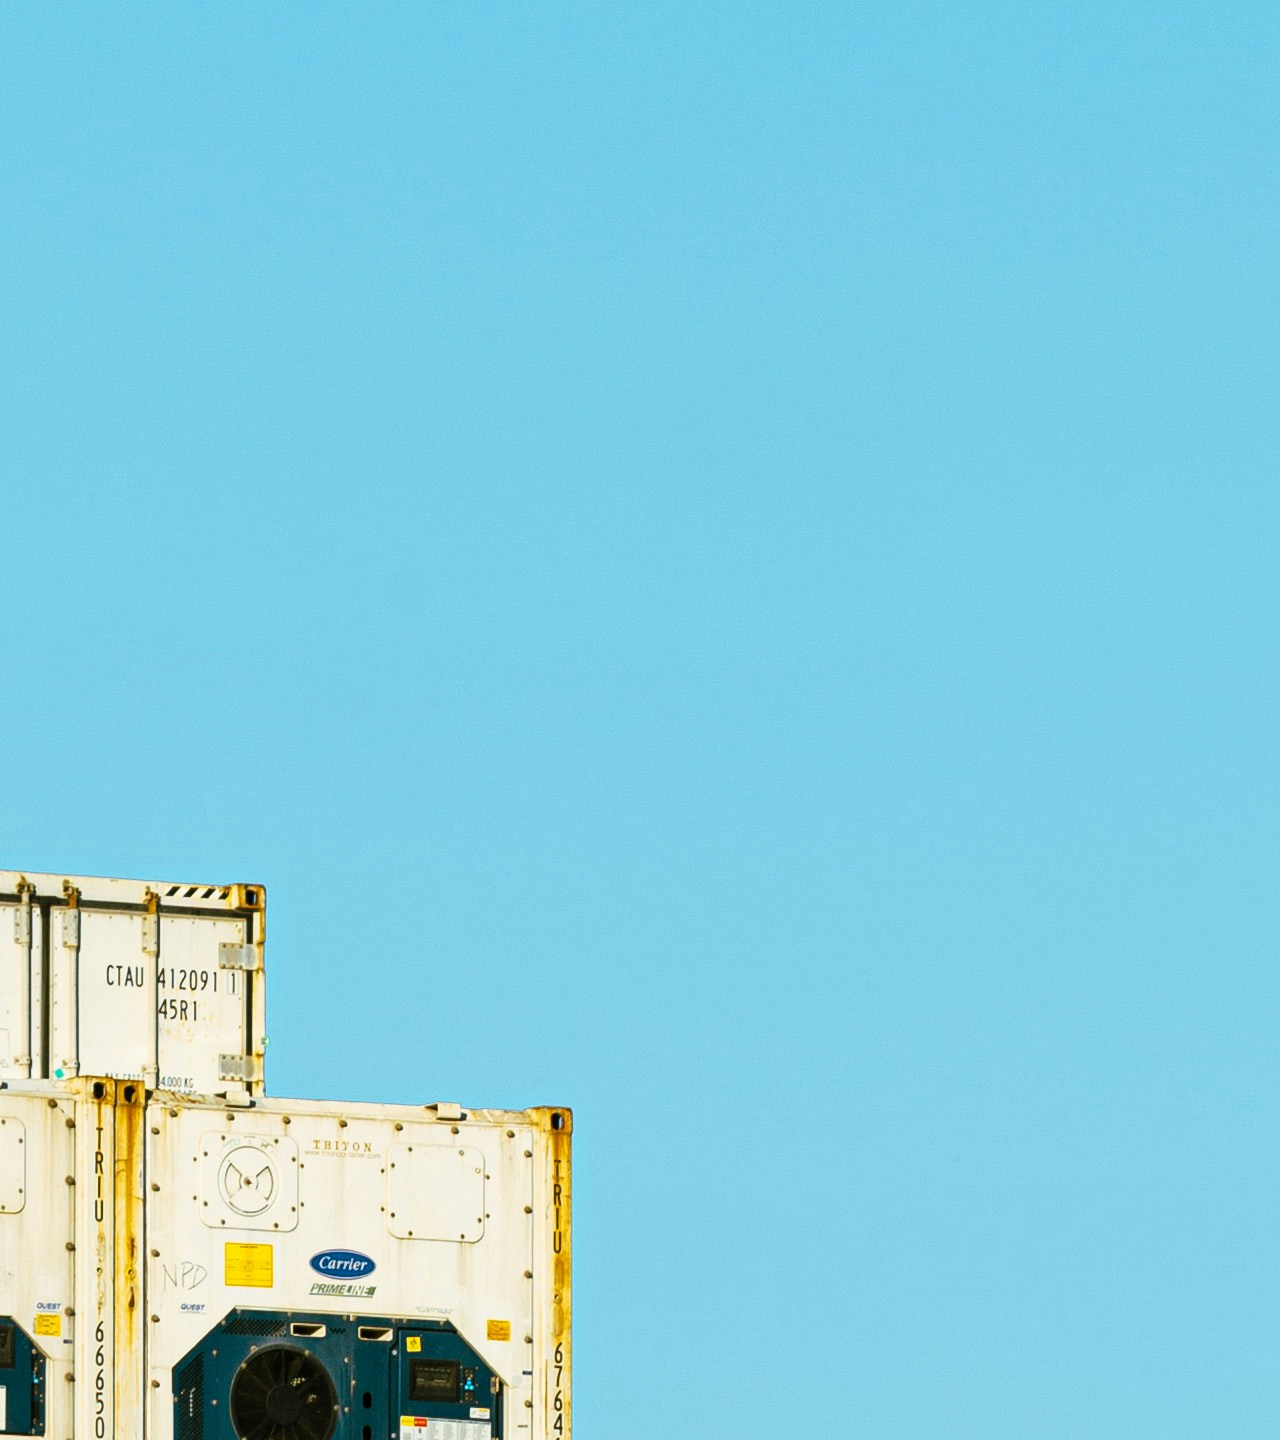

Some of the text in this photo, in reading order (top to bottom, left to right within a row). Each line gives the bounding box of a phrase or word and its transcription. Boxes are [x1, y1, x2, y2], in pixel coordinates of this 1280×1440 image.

[106, 964, 218, 993] CTAU 412091
[158, 999, 199, 1021] 45R1
[312, 1139, 373, 1152] TRITON
[94, 1127, 105, 1223] TRIU
[553, 1160, 562, 1255] TRIU
[318, 1257, 368, 1272] Carrier
[36, 1301, 62, 1310] QUEST
[180, 1302, 206, 1312] QUEST
